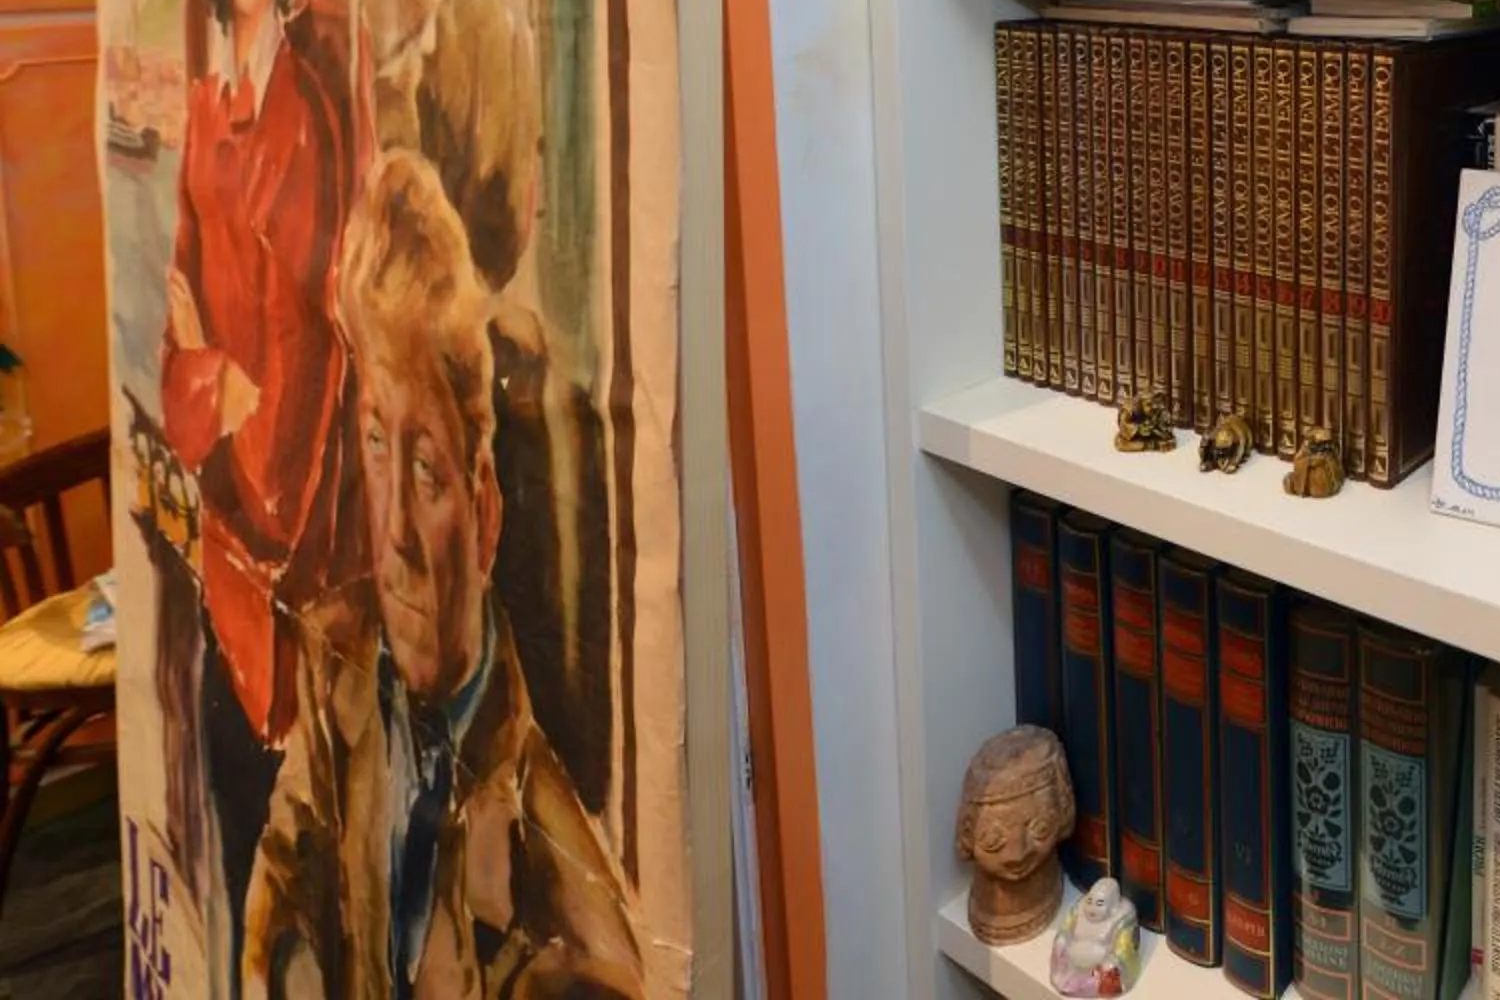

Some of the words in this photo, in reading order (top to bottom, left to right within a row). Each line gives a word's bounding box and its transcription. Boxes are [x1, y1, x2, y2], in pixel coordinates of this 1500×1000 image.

[1213, 54, 1227, 126] TEMPO
[1235, 56, 1249, 128] TEMPO
[1255, 57, 1270, 132] TEMPO
[1276, 59, 1291, 134] TEMPO
[1300, 62, 1314, 137] TEMPO
[1323, 63, 1340, 140] TEMPO
[1347, 64, 1363, 141] TEMPO
[1372, 67, 1389, 147] TEMPO
